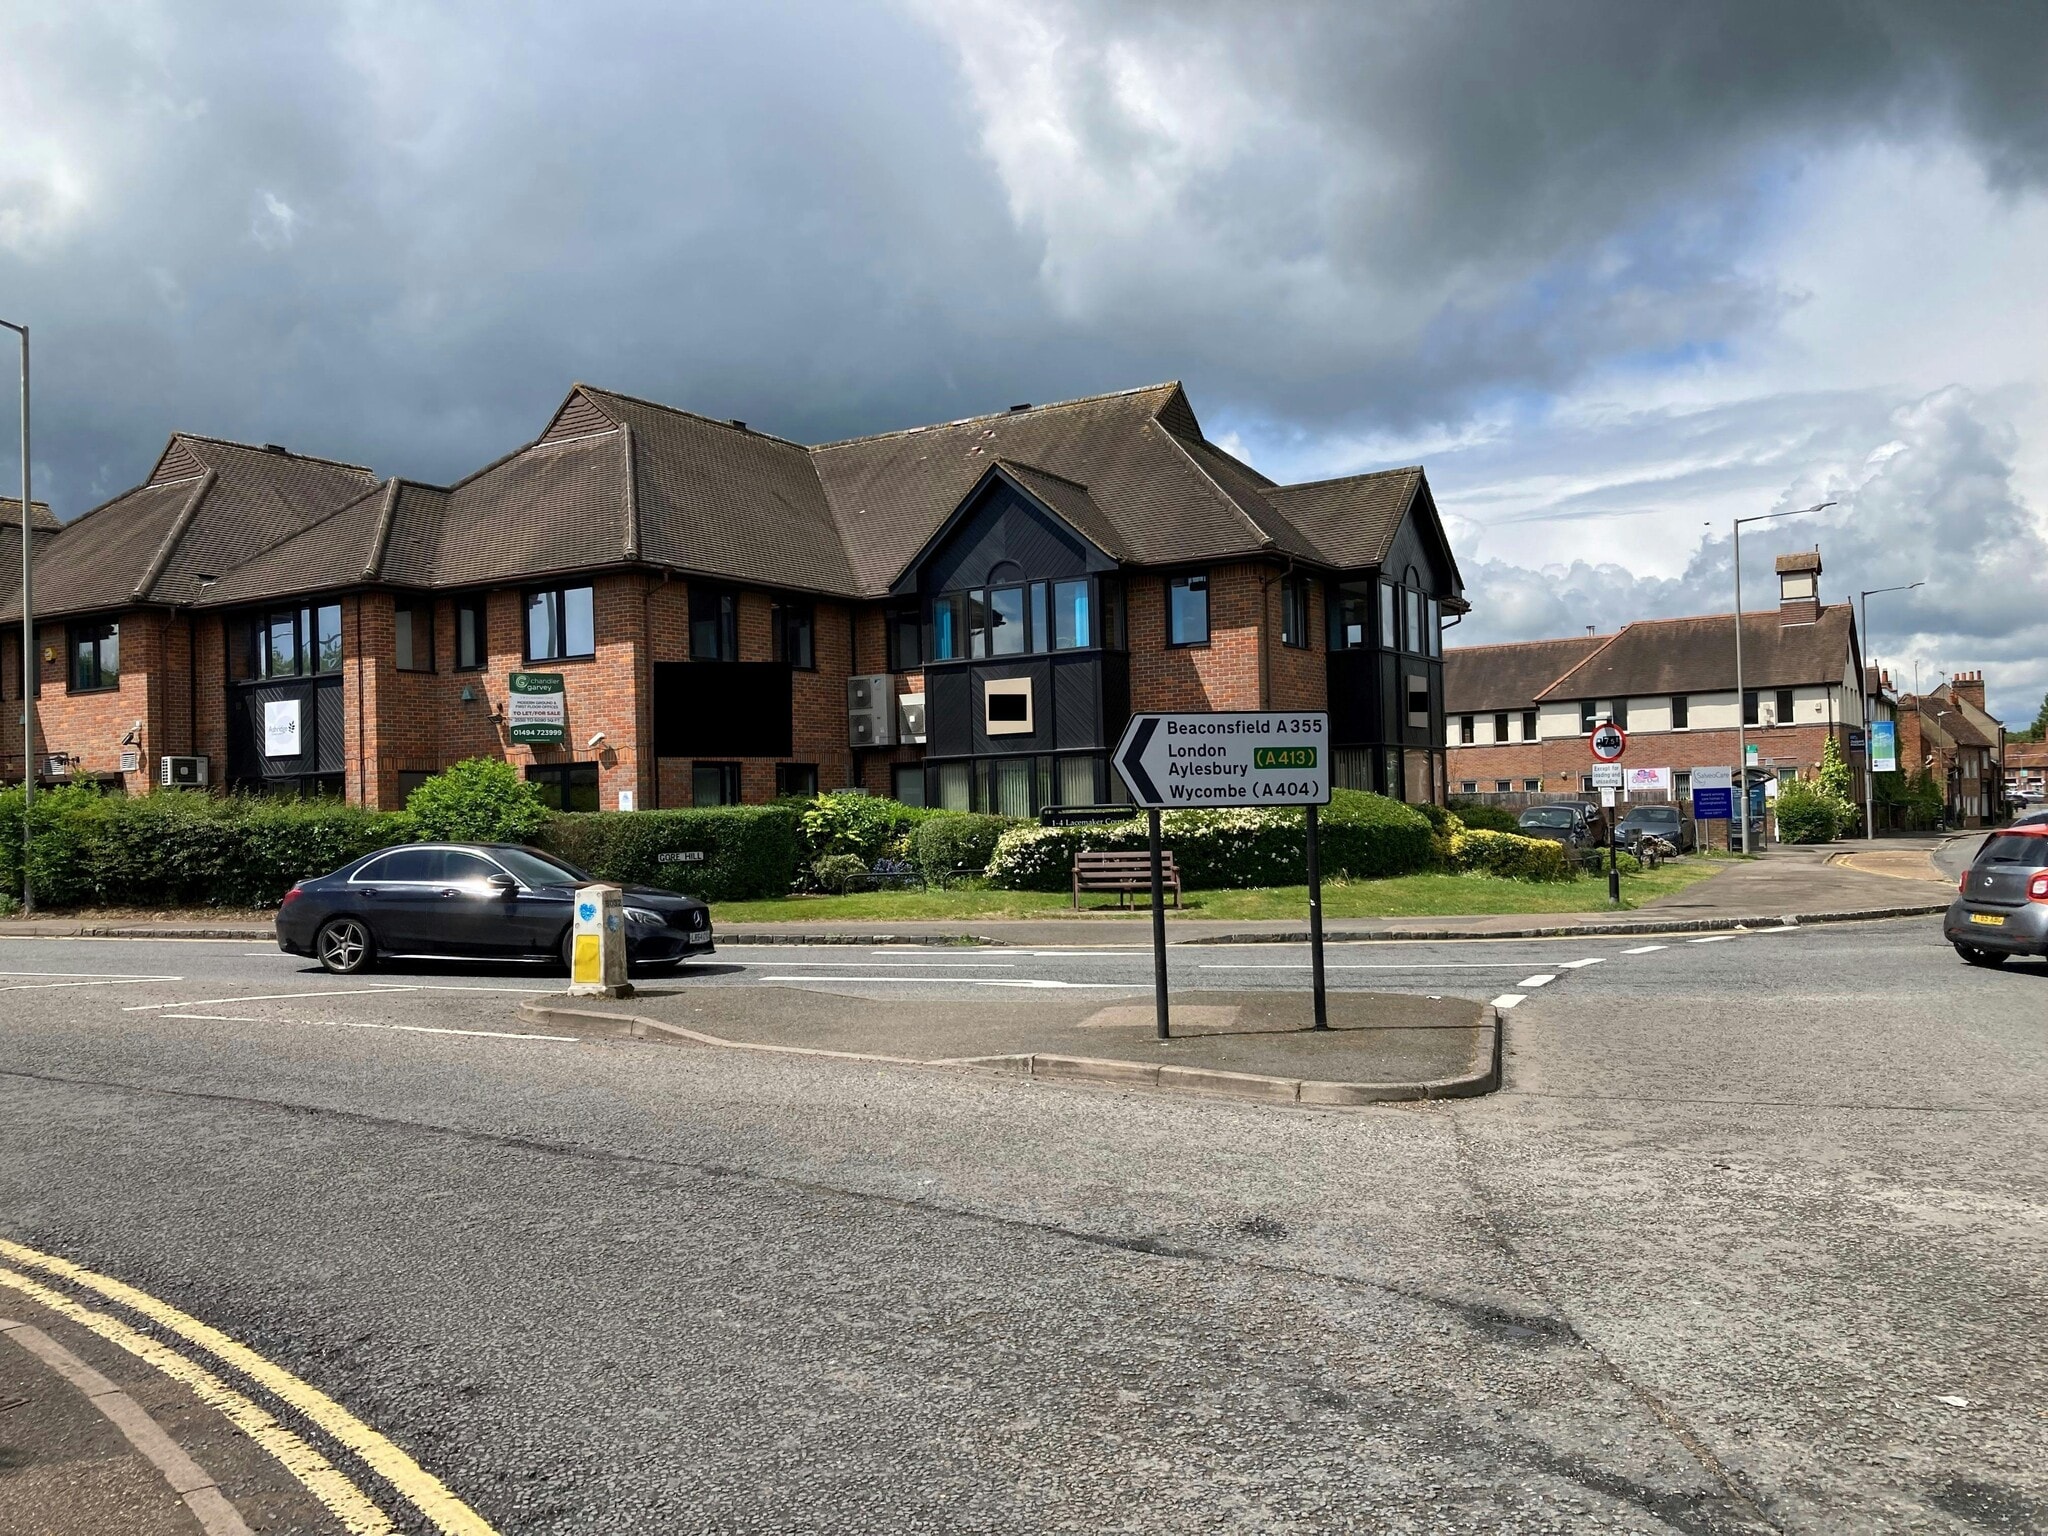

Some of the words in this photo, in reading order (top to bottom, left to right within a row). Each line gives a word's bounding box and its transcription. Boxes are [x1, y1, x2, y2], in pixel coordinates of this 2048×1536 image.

[1167, 719, 1270, 735] Beaconsfield
[1168, 743, 1227, 758] London
[1256, 749, 1315, 766] (A413)
[1168, 761, 1248, 779] Aylesbury
[1169, 783, 1247, 802] Wycombe
[1252, 780, 1319, 799] (A404)
[660, 854, 681, 862] GORE
